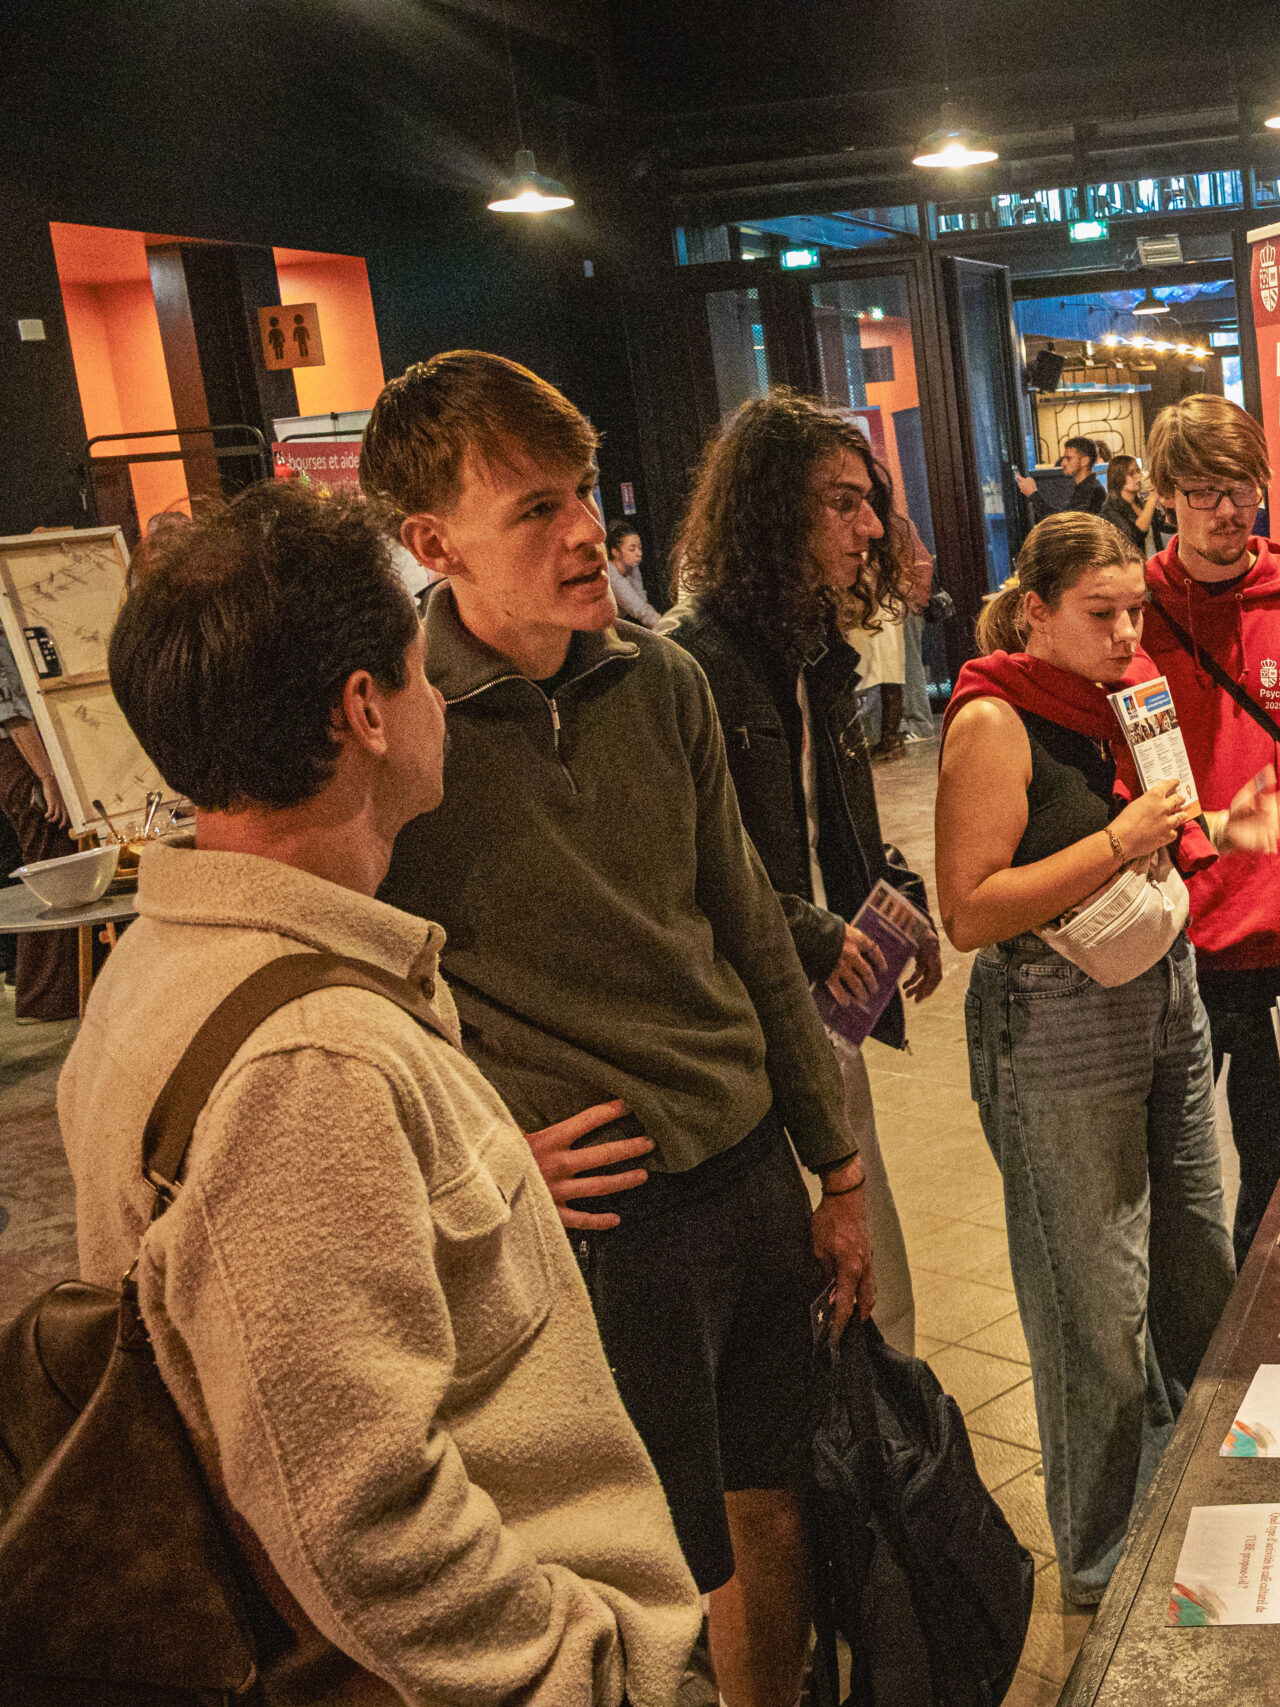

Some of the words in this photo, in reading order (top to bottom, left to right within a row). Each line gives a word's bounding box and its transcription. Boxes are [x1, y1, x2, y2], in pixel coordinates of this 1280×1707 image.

[288, 452, 327, 471] bourses
[329, 454, 339, 470] et
[340, 451, 360, 469] aide
[1269, 1512, 1280, 1525] Quel
[1266, 1526, 1277, 1536] type
[1264, 1537, 1278, 1564] d'activités
[1261, 1571, 1272, 1582] café
[1257, 1583, 1270, 1605] culturel
